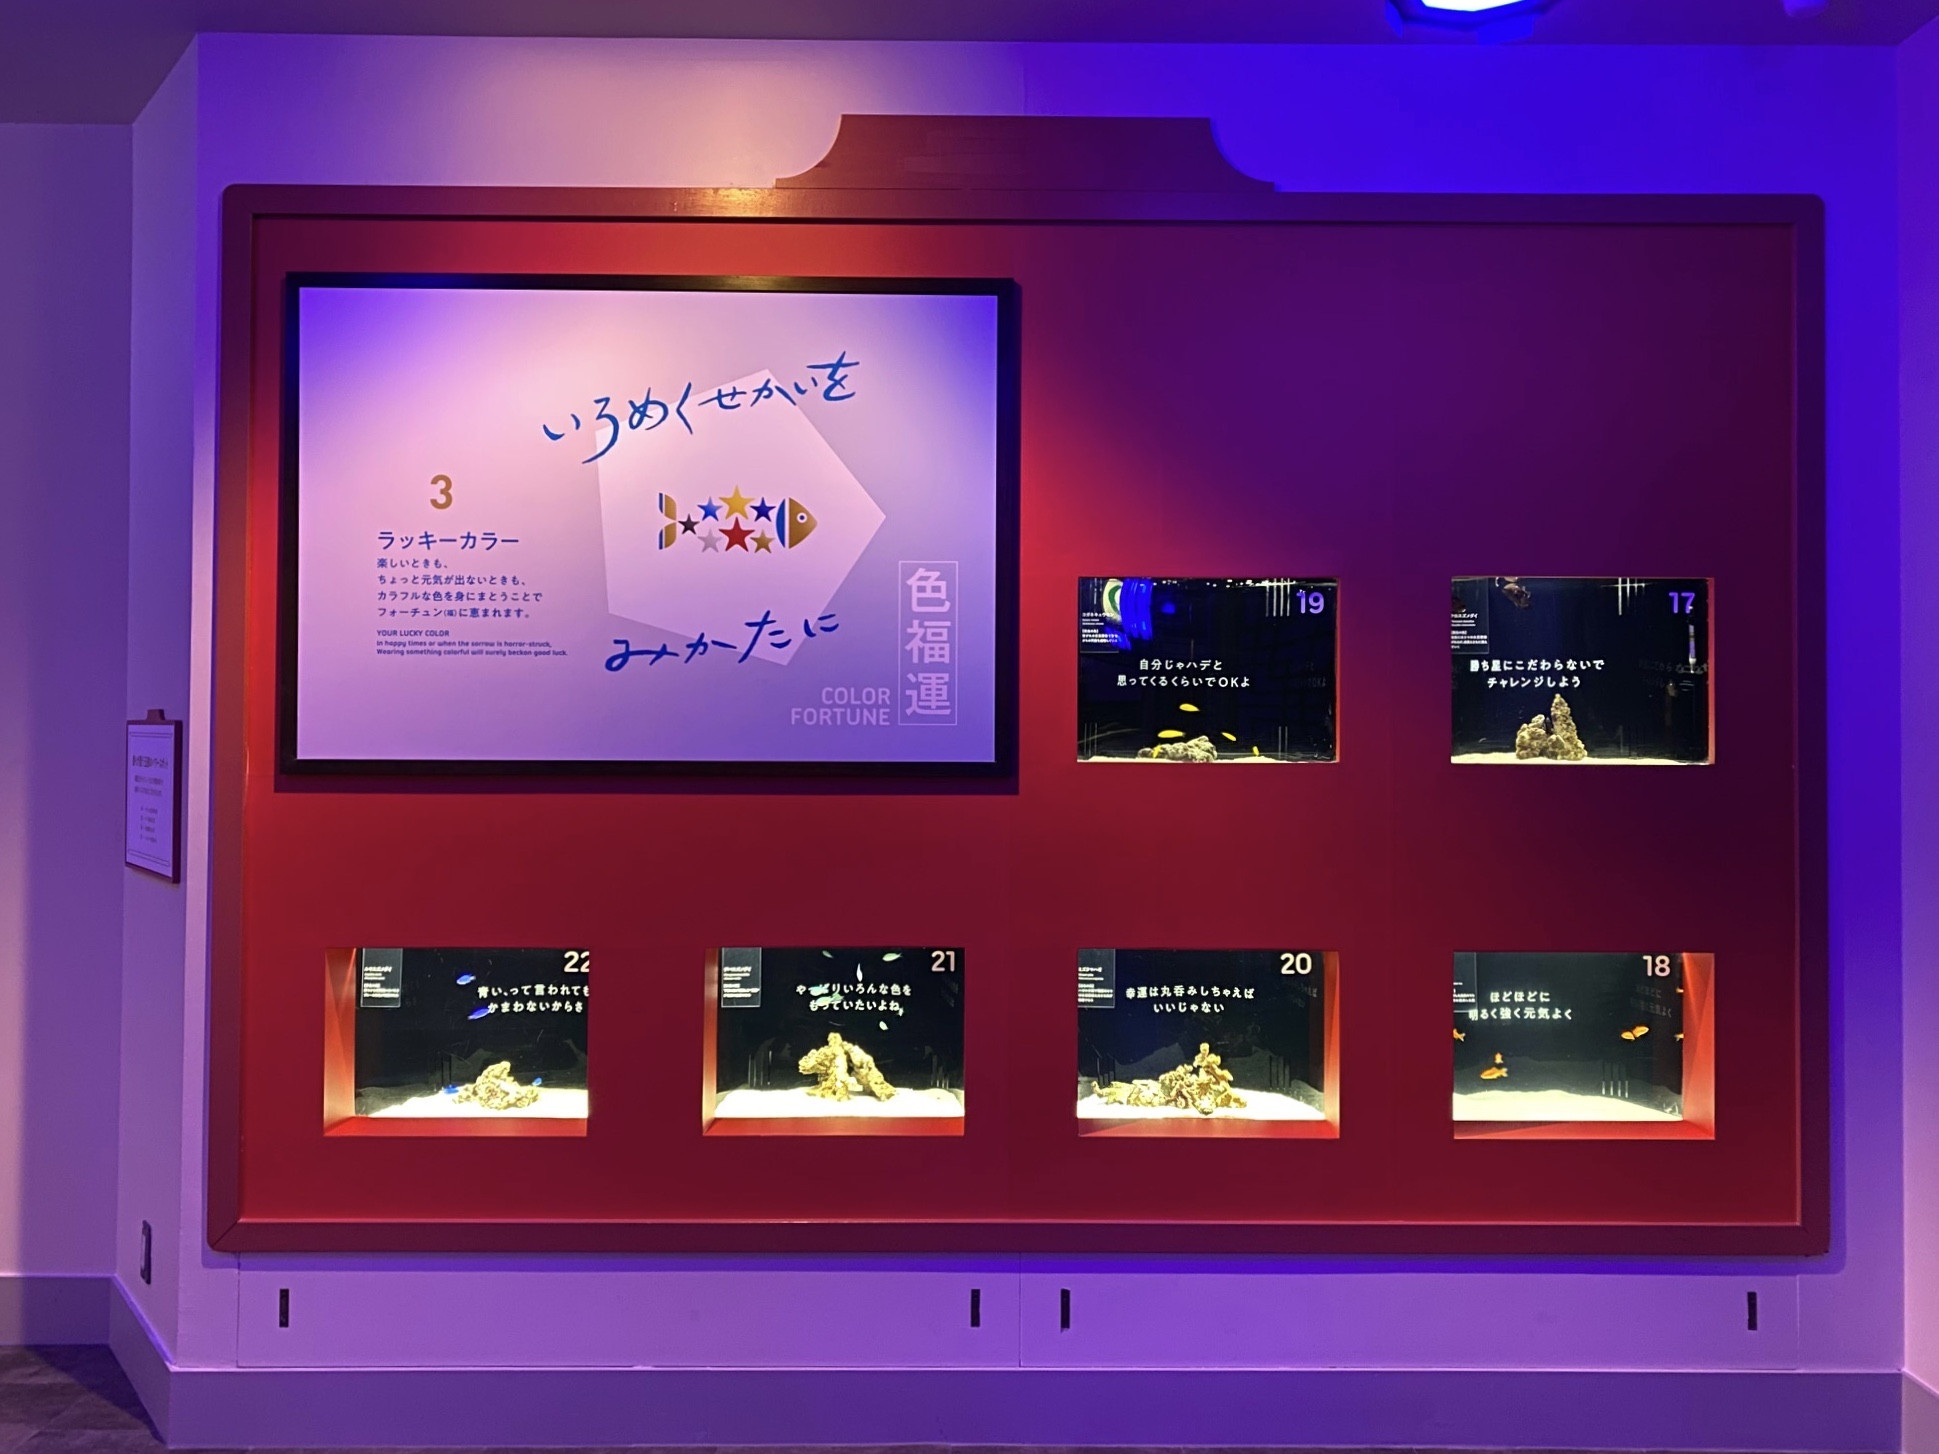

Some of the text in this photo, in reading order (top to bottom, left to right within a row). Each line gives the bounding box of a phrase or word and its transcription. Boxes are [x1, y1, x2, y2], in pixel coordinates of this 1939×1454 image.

[542, 350, 860, 465] いろめくせかいを
[429, 474, 453, 510] 3
[378, 531, 519, 551] ラッキーカラー
[376, 558, 449, 569] 楽しいときも、
[377, 574, 527, 586] ちょっと元気が出ないときも、
[377, 591, 543, 602] カラフルな色を身にまとうことで
[1297, 592, 1325, 614] 19
[1669, 592, 1696, 614] 17
[376, 629, 450, 637] YOUR LUCKY COLOR
[604, 609, 840, 672] みかたに
[904, 567, 951, 717] 色福運
[406, 649, 442, 657] something
[533, 649, 551, 657] good
[1139, 659, 1223, 671] 自分じゃハデと
[1469, 659, 1605, 672] 勝ち星にこだわらないで
[1117, 674, 1250, 688] 思ってくるくらいでOKよ
[1487, 676, 1581, 689] チャレンジしよう
[821, 687, 891, 705] COLOR
[791, 708, 891, 726] FORTUNE
[563, 951, 589, 973] 22
[931, 950, 956, 972] 21
[1280, 953, 1312, 975] 20
[1643, 955, 1671, 977] 18
[796, 983, 912, 996] やりいろんな色を
[1125, 985, 1255, 999] 幸運は丸呑みしちゃえば
[1489, 991, 1551, 1003] ほどほどに
[487, 1001, 583, 1013] かまわないからさ
[1153, 1002, 1225, 1013] いいじゃない
[1468, 1008, 1573, 1021] 明るく強く元気よく
